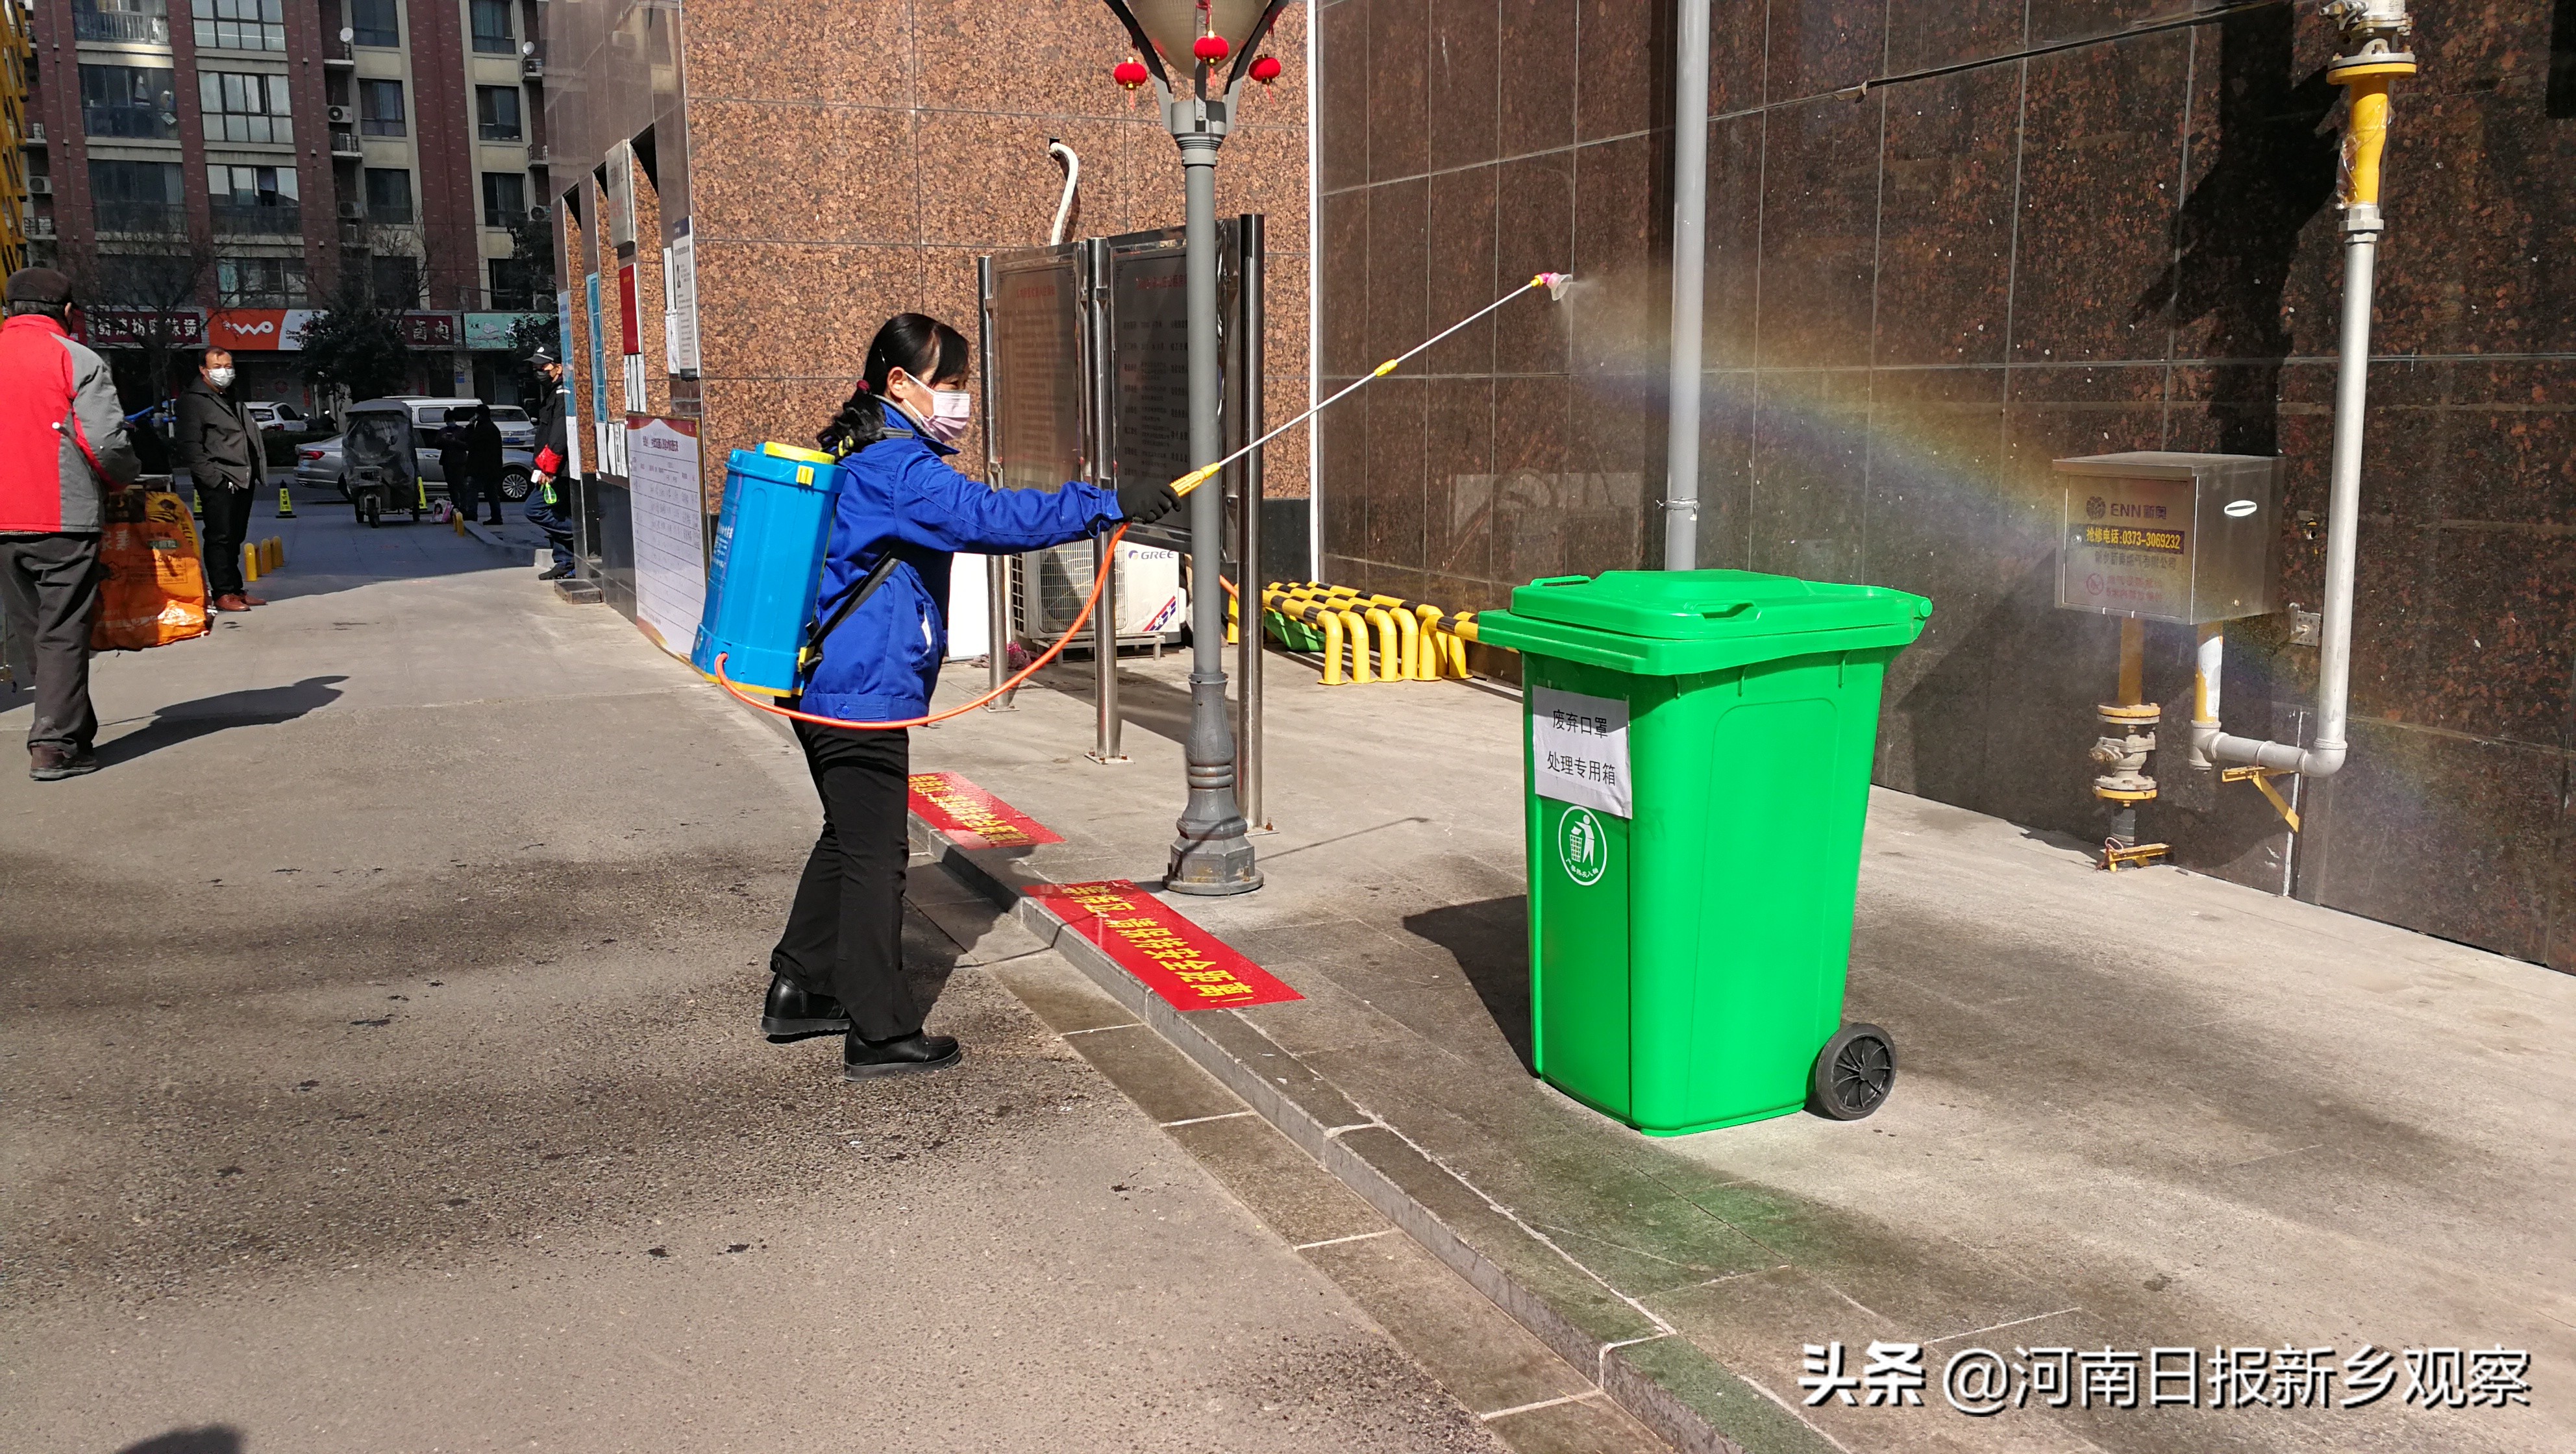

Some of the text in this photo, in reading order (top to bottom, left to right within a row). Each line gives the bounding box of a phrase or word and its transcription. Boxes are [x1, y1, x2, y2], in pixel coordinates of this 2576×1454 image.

[2111, 503, 2167, 520] ENN 新奥
[1141, 550, 1174, 560] GREE
[1552, 709, 1609, 739] 废弃口罩
[1547, 750, 1616, 787] 处理专用箱
